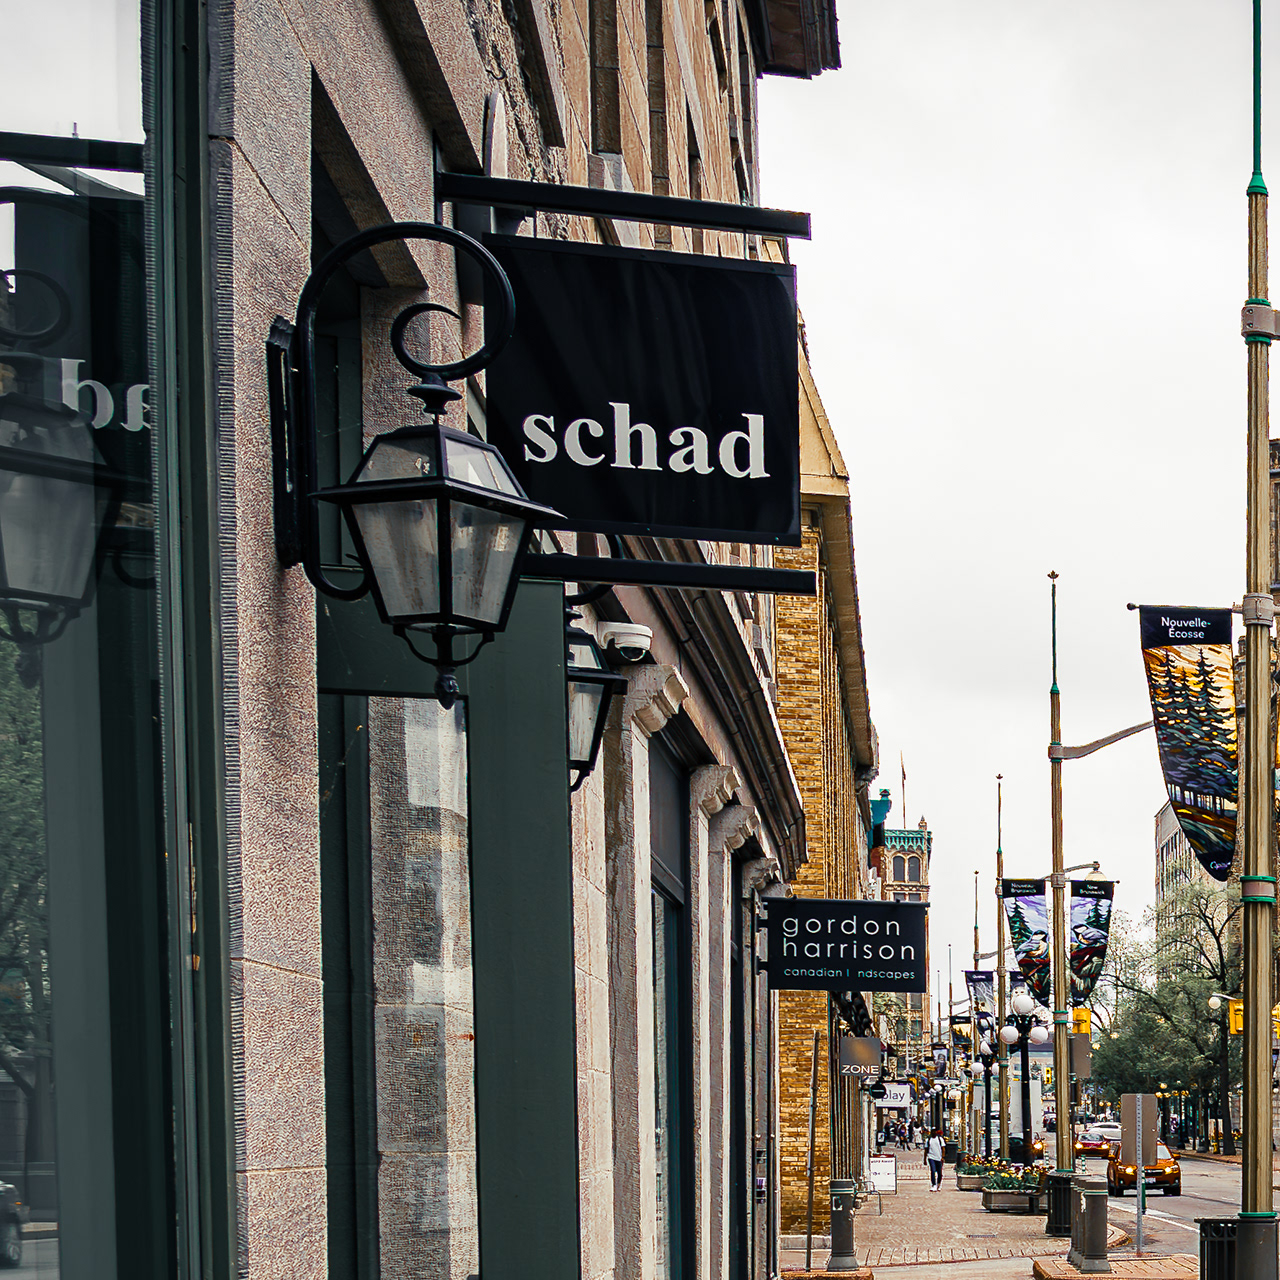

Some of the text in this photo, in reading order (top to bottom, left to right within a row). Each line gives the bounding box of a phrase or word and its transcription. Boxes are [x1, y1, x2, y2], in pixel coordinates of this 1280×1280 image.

[522, 401, 771, 479] schad
[1161, 616, 1211, 628] Nouvelle-
[1168, 625, 1205, 639] Écosse
[782, 915, 900, 938] gordon
[783, 937, 915, 960] harrison
[784, 968, 843, 977] canadian
[841, 1064, 880, 1074] ZONE
